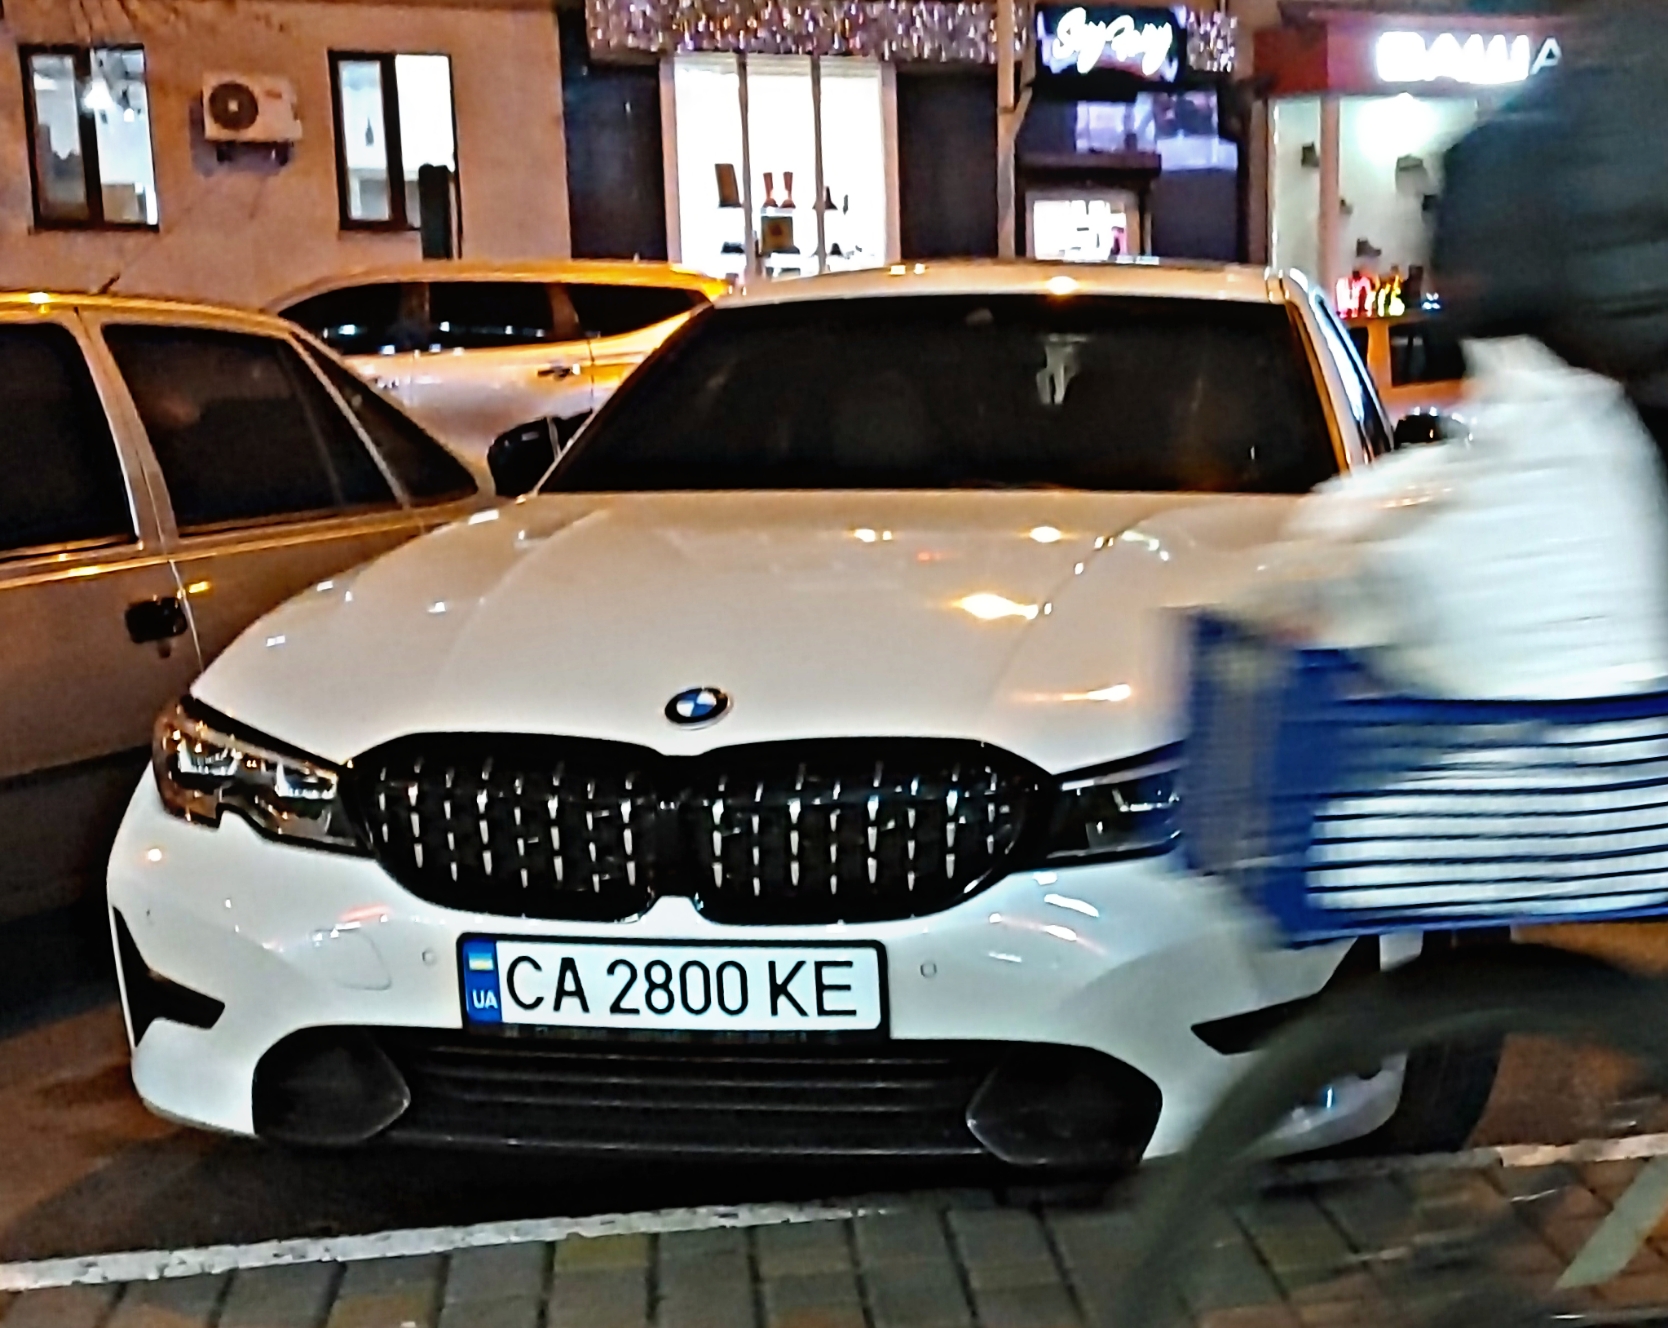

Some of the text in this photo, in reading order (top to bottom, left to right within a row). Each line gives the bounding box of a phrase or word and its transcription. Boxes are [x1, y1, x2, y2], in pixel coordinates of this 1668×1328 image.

[472, 990, 499, 1010] UA
[506, 955, 858, 1018] CA 2800 KE
